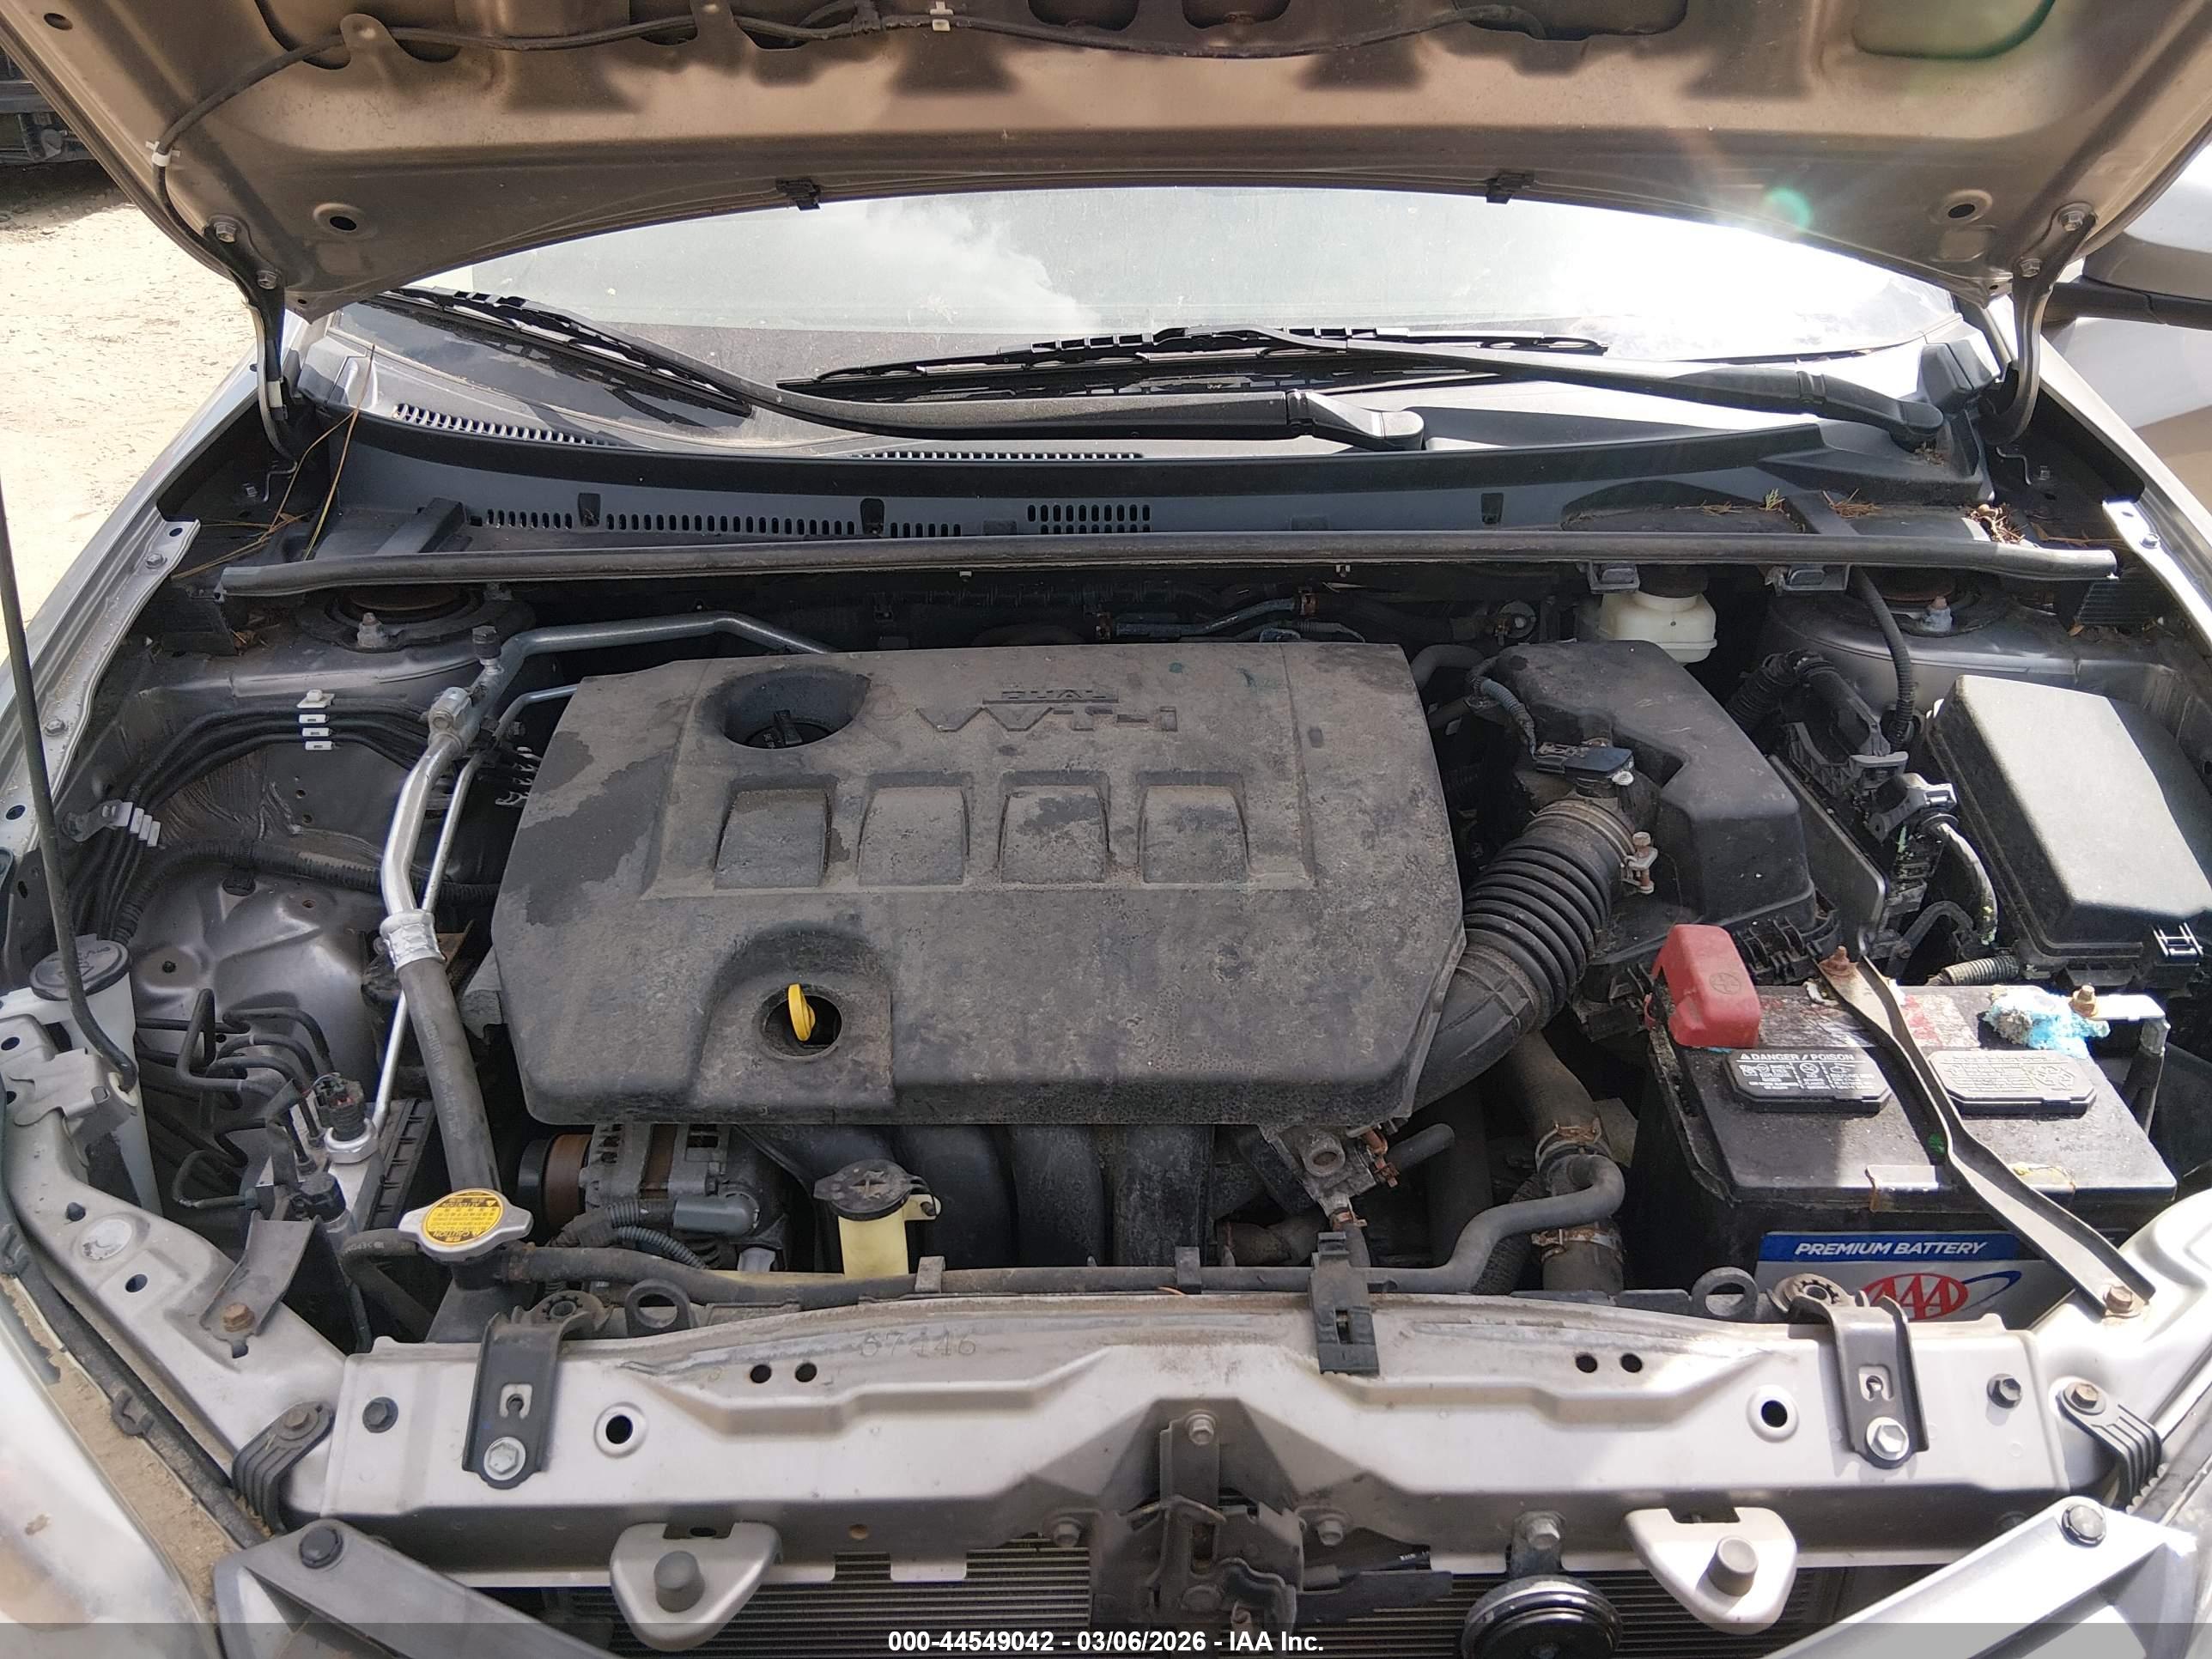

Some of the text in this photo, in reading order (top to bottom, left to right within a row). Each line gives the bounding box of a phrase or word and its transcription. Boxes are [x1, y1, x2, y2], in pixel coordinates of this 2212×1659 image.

[1795, 1242, 1988, 1255] PREMIUM BATTERY
[1869, 1274, 1954, 1320] AAA
